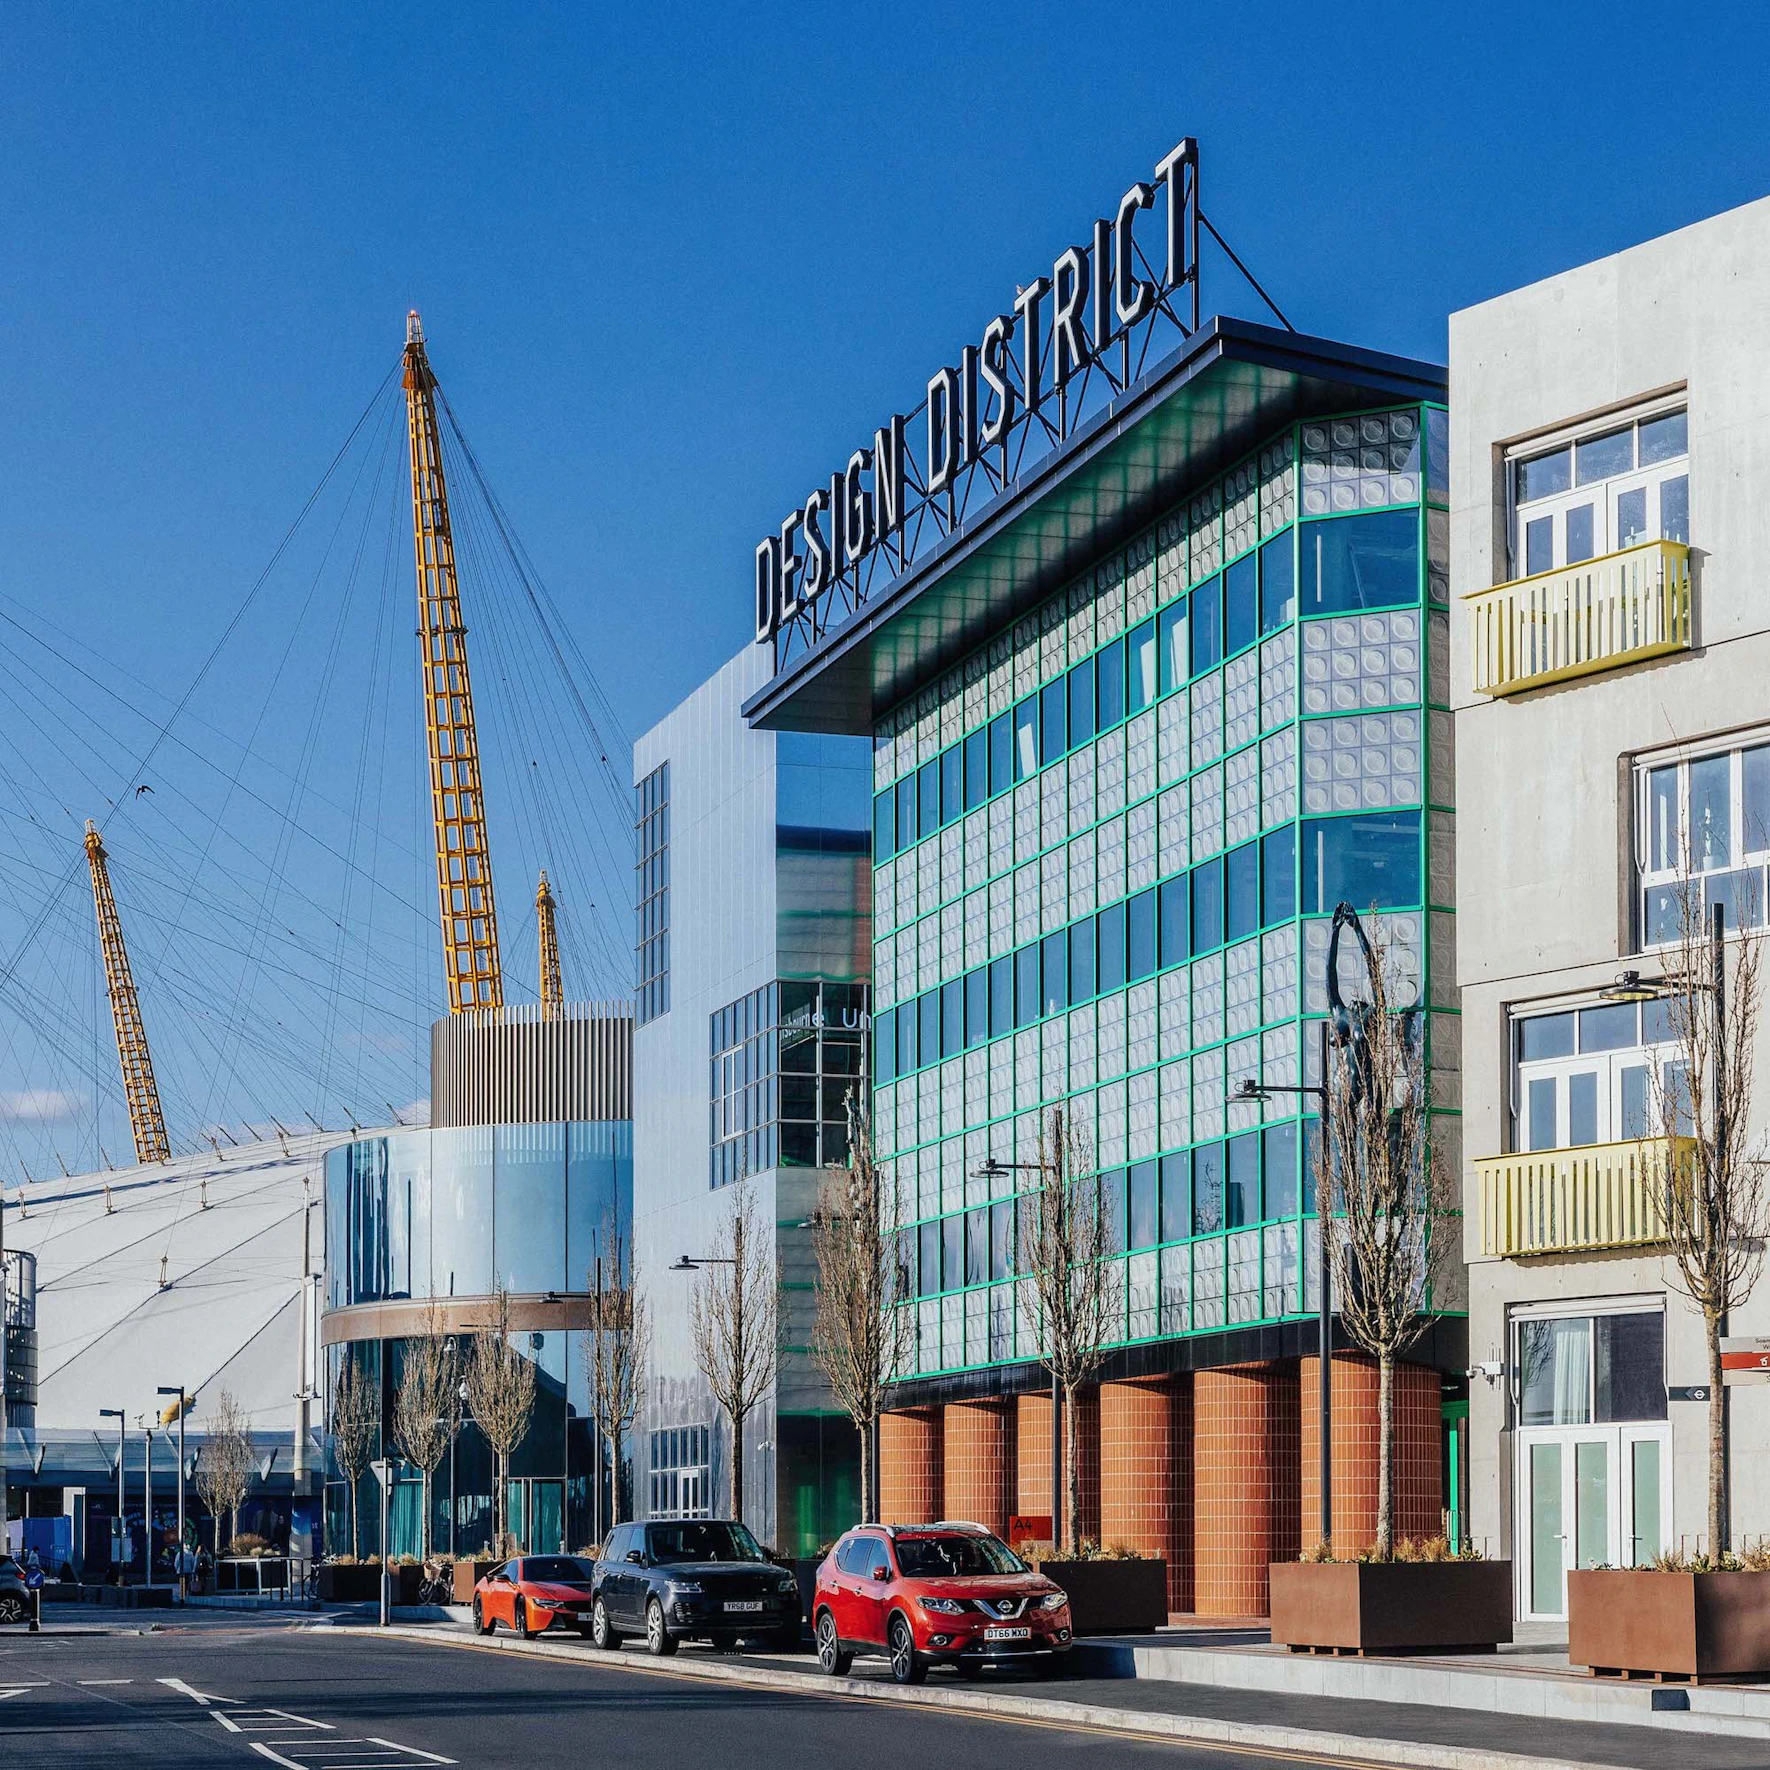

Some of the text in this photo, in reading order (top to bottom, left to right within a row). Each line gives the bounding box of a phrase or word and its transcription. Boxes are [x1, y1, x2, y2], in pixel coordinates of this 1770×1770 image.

[755, 137, 1199, 645] DESIGN DISTRICT
[1014, 1519, 1033, 1531] A4
